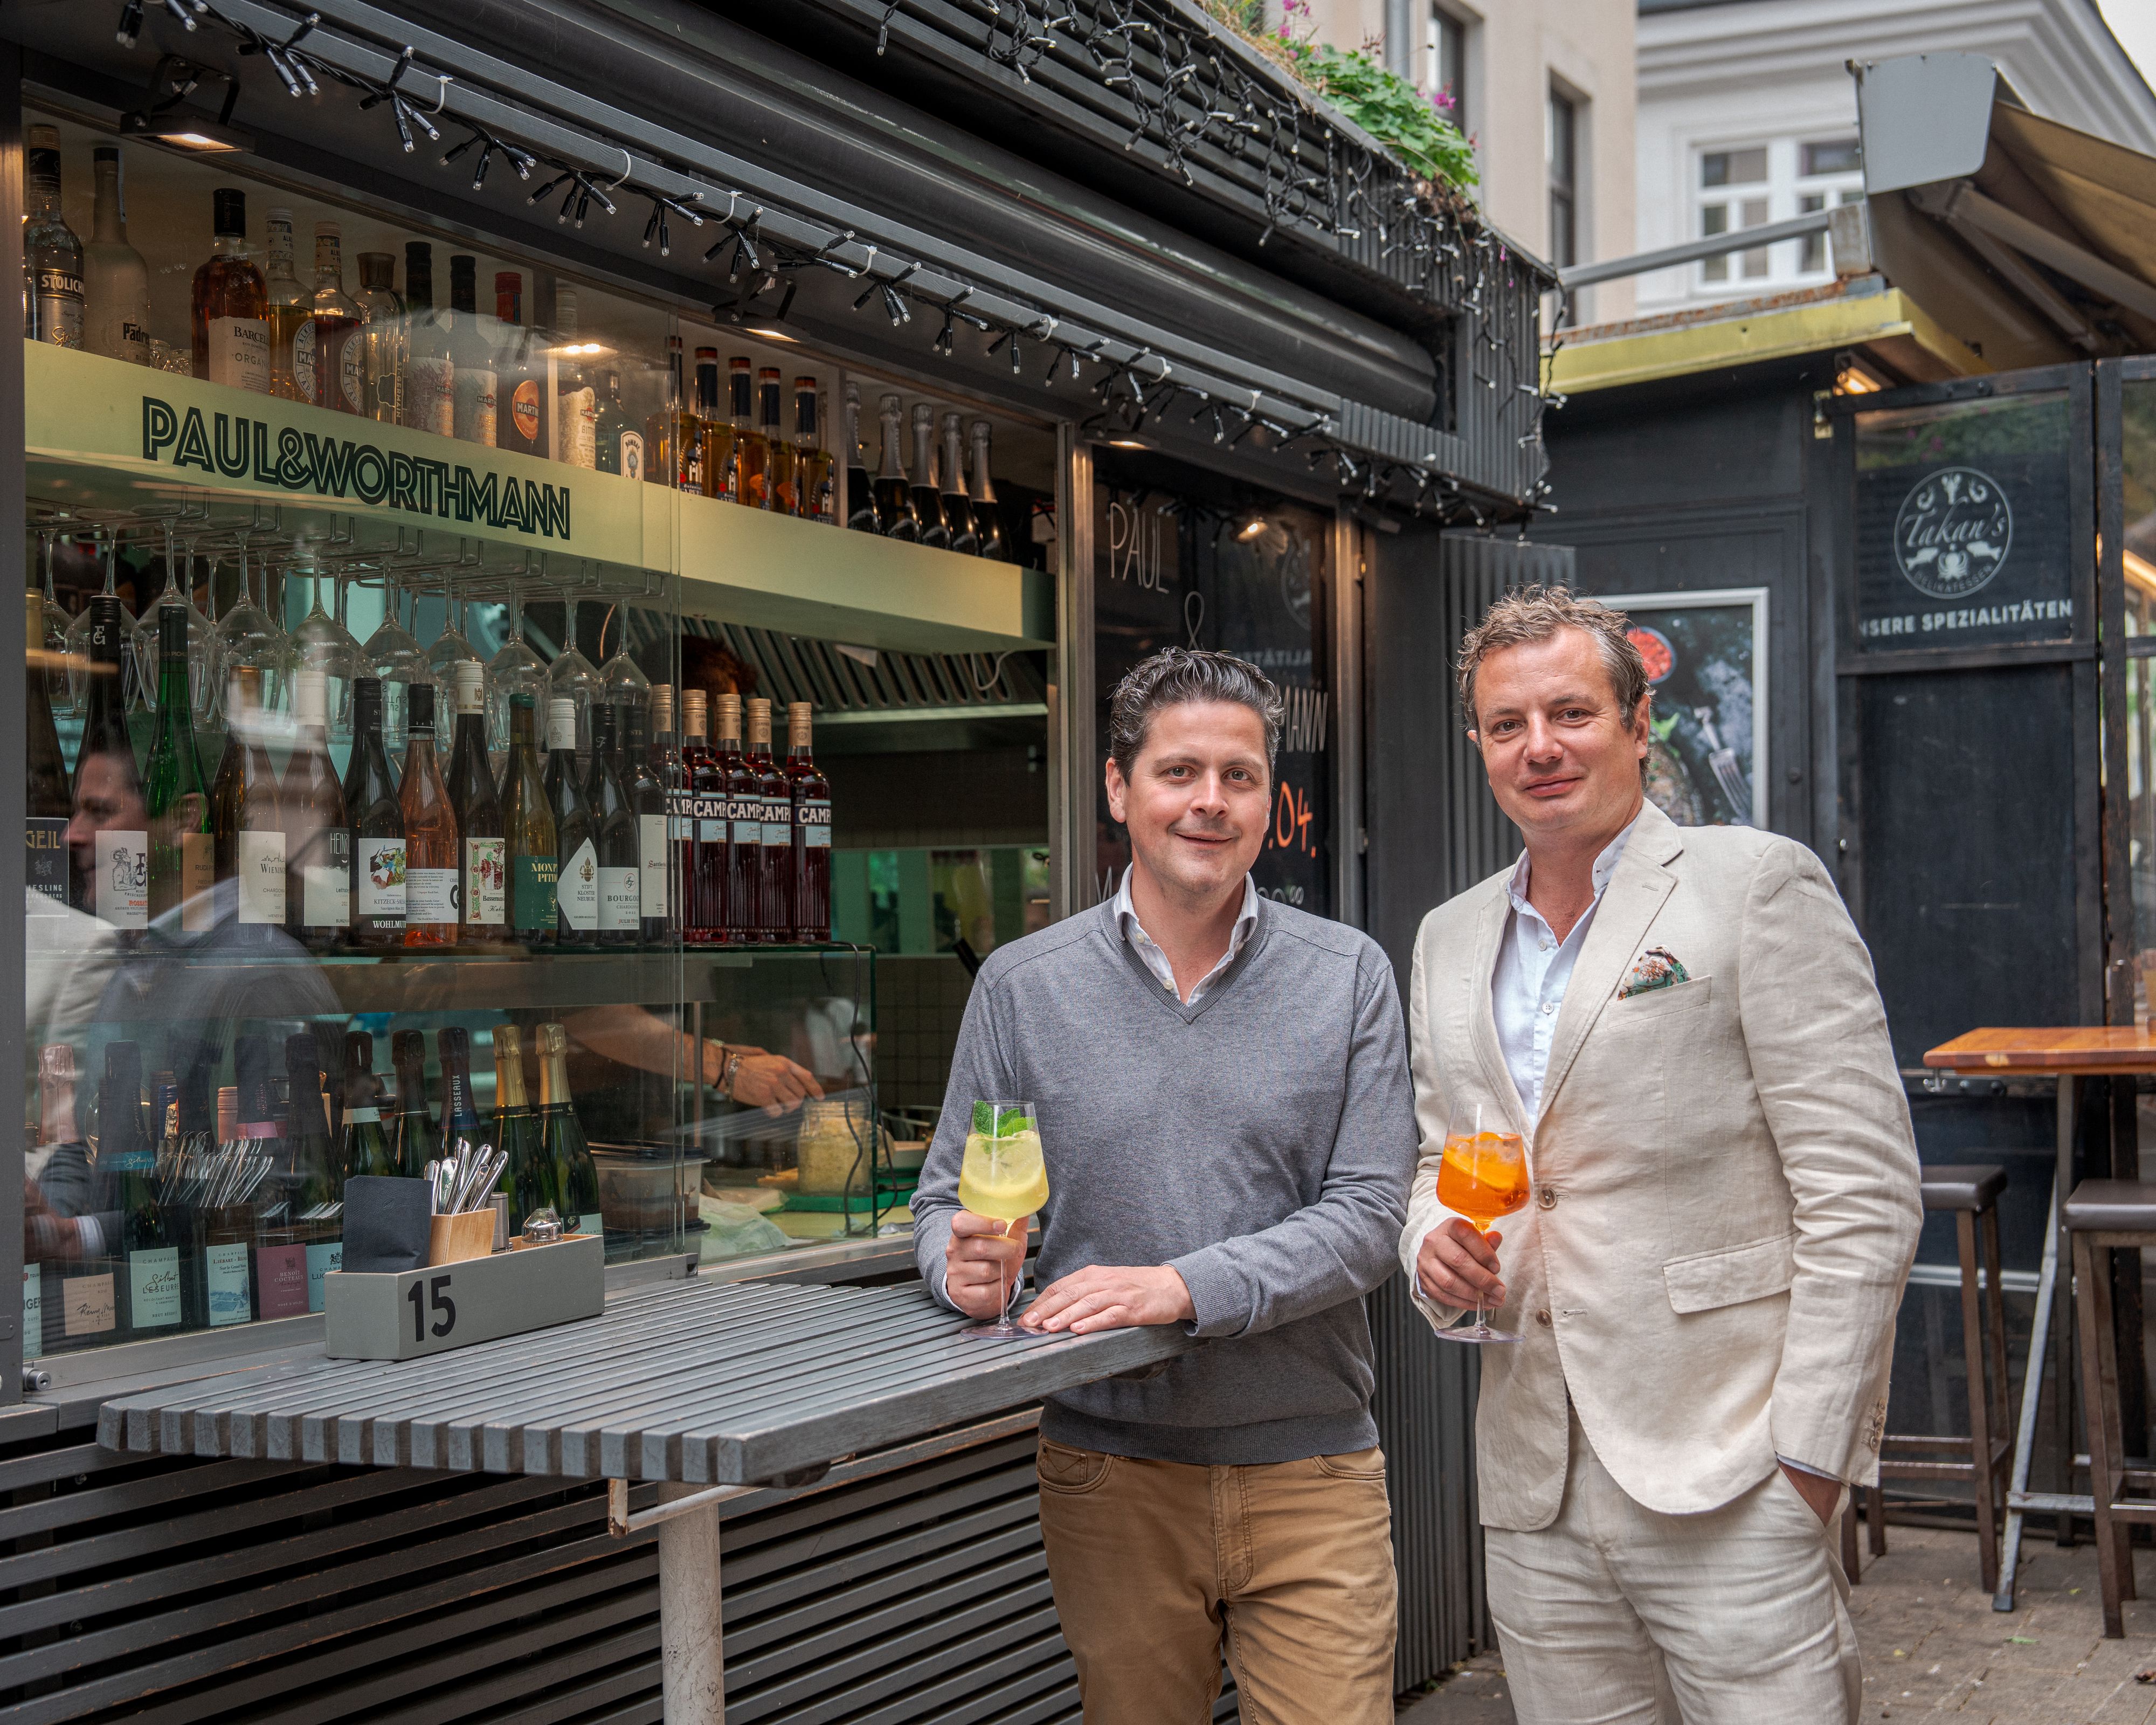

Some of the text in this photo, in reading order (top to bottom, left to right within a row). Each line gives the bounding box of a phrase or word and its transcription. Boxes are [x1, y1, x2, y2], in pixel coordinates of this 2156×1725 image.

[142, 396, 571, 540] PAUL&WORTHMANN
[1110, 501, 1170, 594] PAUL
[1921, 598, 2074, 633] SPEZIALITÄTEN
[26, 830, 61, 849] GEIL
[452, 1075, 462, 1117] LASSEAUX
[143, 1282, 179, 1294] LESEURRE
[407, 1274, 456, 1342] 15
